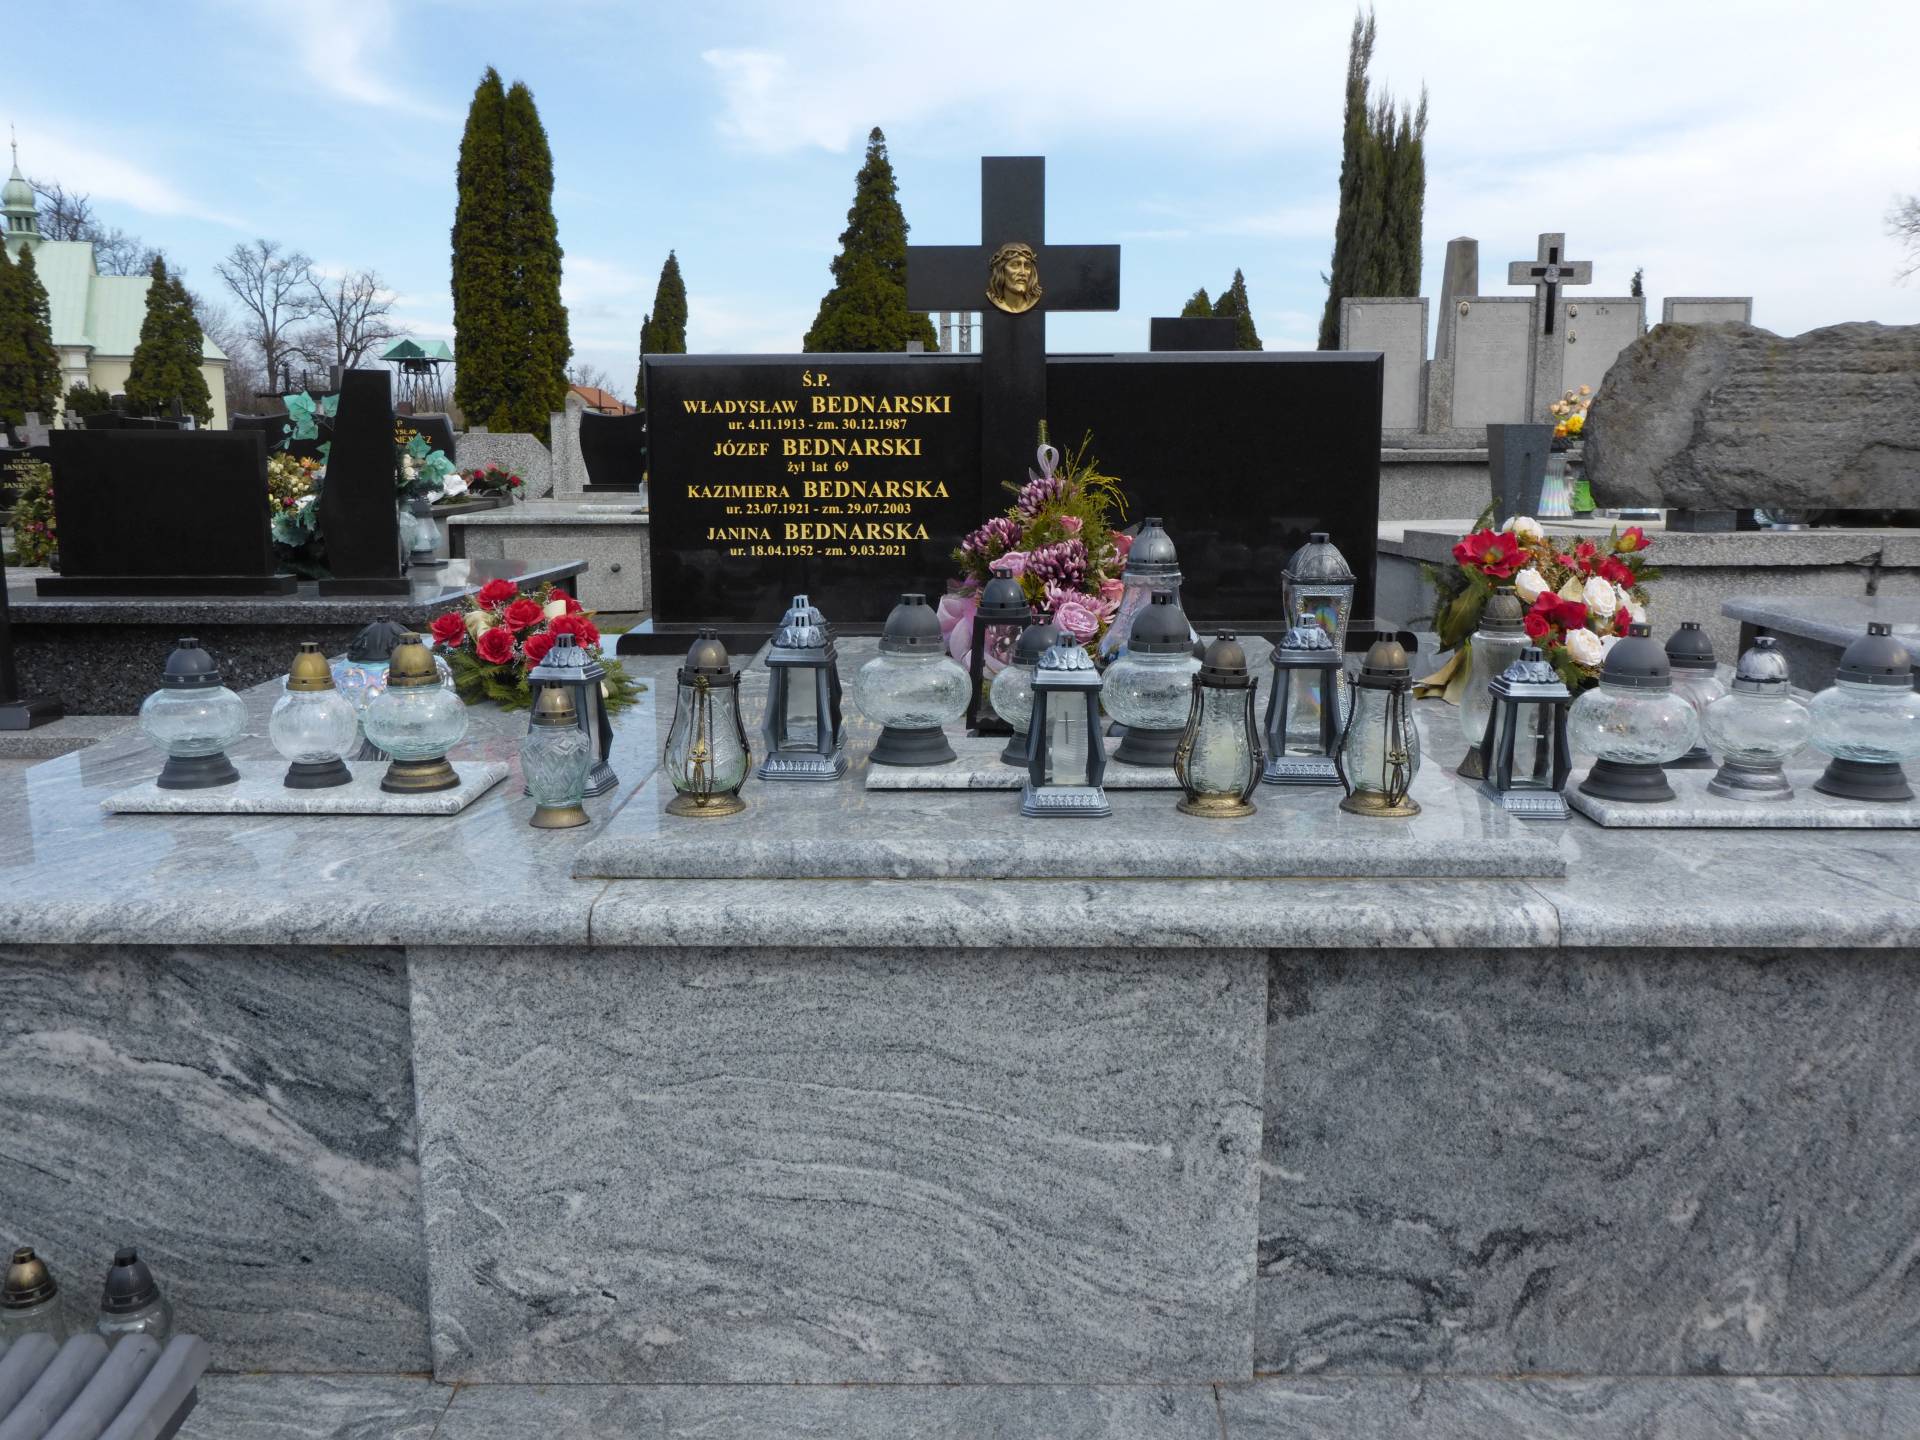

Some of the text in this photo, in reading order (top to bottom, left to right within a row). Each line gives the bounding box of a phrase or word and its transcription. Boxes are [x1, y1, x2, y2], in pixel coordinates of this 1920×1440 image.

[802, 370, 831, 387] Ś.P.
[683, 396, 951, 414] WŁADYSŁAW BEDNARSKI
[728, 421, 744, 430] ur.
[748, 419, 805, 430] 4.11.1913
[816, 421, 839, 430] zm.
[842, 419, 907, 430] 30.12.1987
[713, 438, 922, 456] JÓZEF BEDNARSKI
[787, 461, 849, 474] żył lat 69
[687, 481, 950, 499] KAZIMIERA BEDNARSKA
[726, 505, 742, 514] ur.
[746, 503, 809, 514] 23.07.1921
[821, 505, 843, 514] zm.
[847, 503, 911, 514] 29.07.2003
[706, 523, 930, 541] JANINA BEDNARSKA
[729, 547, 746, 556] ur.
[750, 545, 814, 556] 18.04.1952
[825, 547, 847, 556] zm.
[850, 545, 906, 556] 9.03.2021
